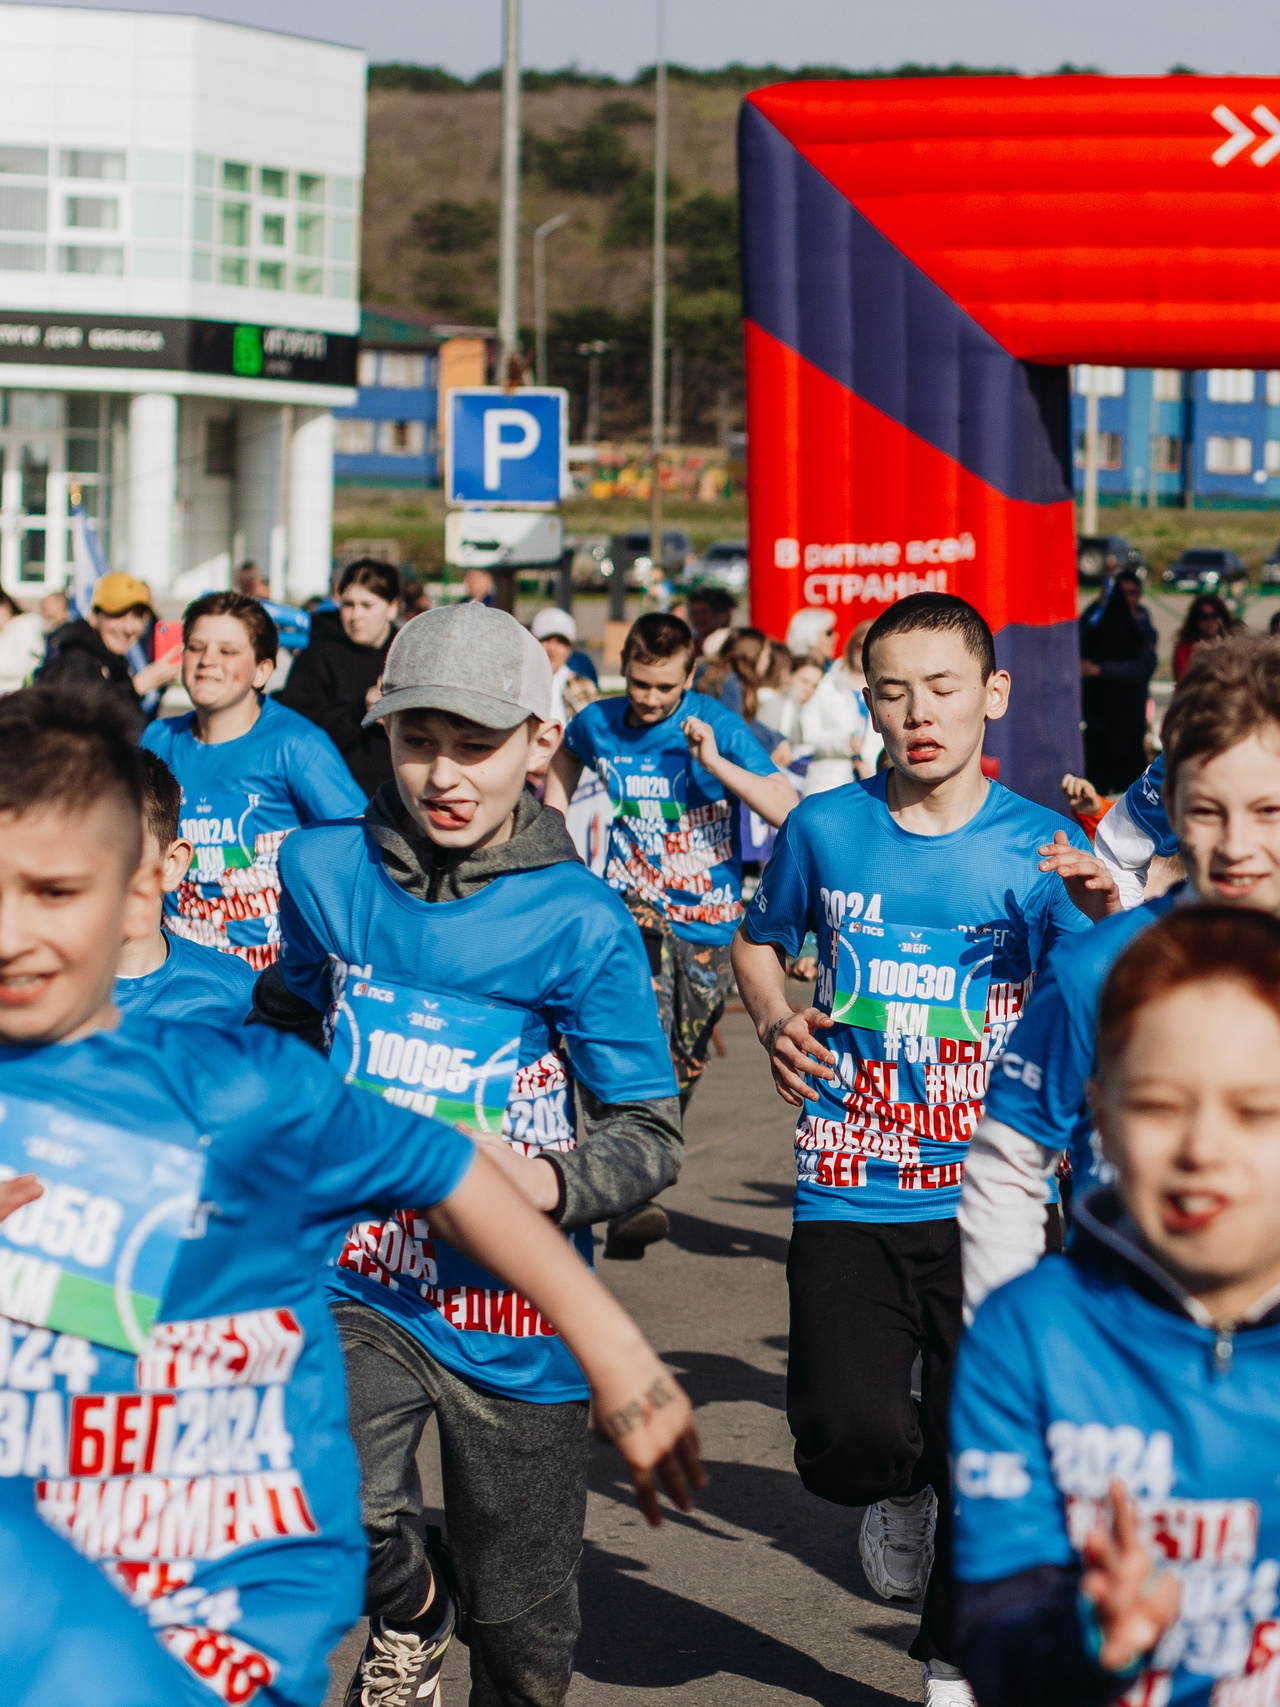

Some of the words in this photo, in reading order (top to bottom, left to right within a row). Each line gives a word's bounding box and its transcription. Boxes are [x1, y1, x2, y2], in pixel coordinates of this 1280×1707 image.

[774, 537, 799, 569] В
[803, 540, 902, 573] ритме
[905, 530, 977, 566] всей
[179, 817, 238, 846] 10024
[819, 886, 884, 932] 2024
[862, 927, 885, 938] ПСБ
[368, 986, 395, 1004] ПСБ
[868, 957, 957, 1002] 10030
[885, 1001, 931, 1038] 1КМ
[366, 1029, 477, 1094] 10095
